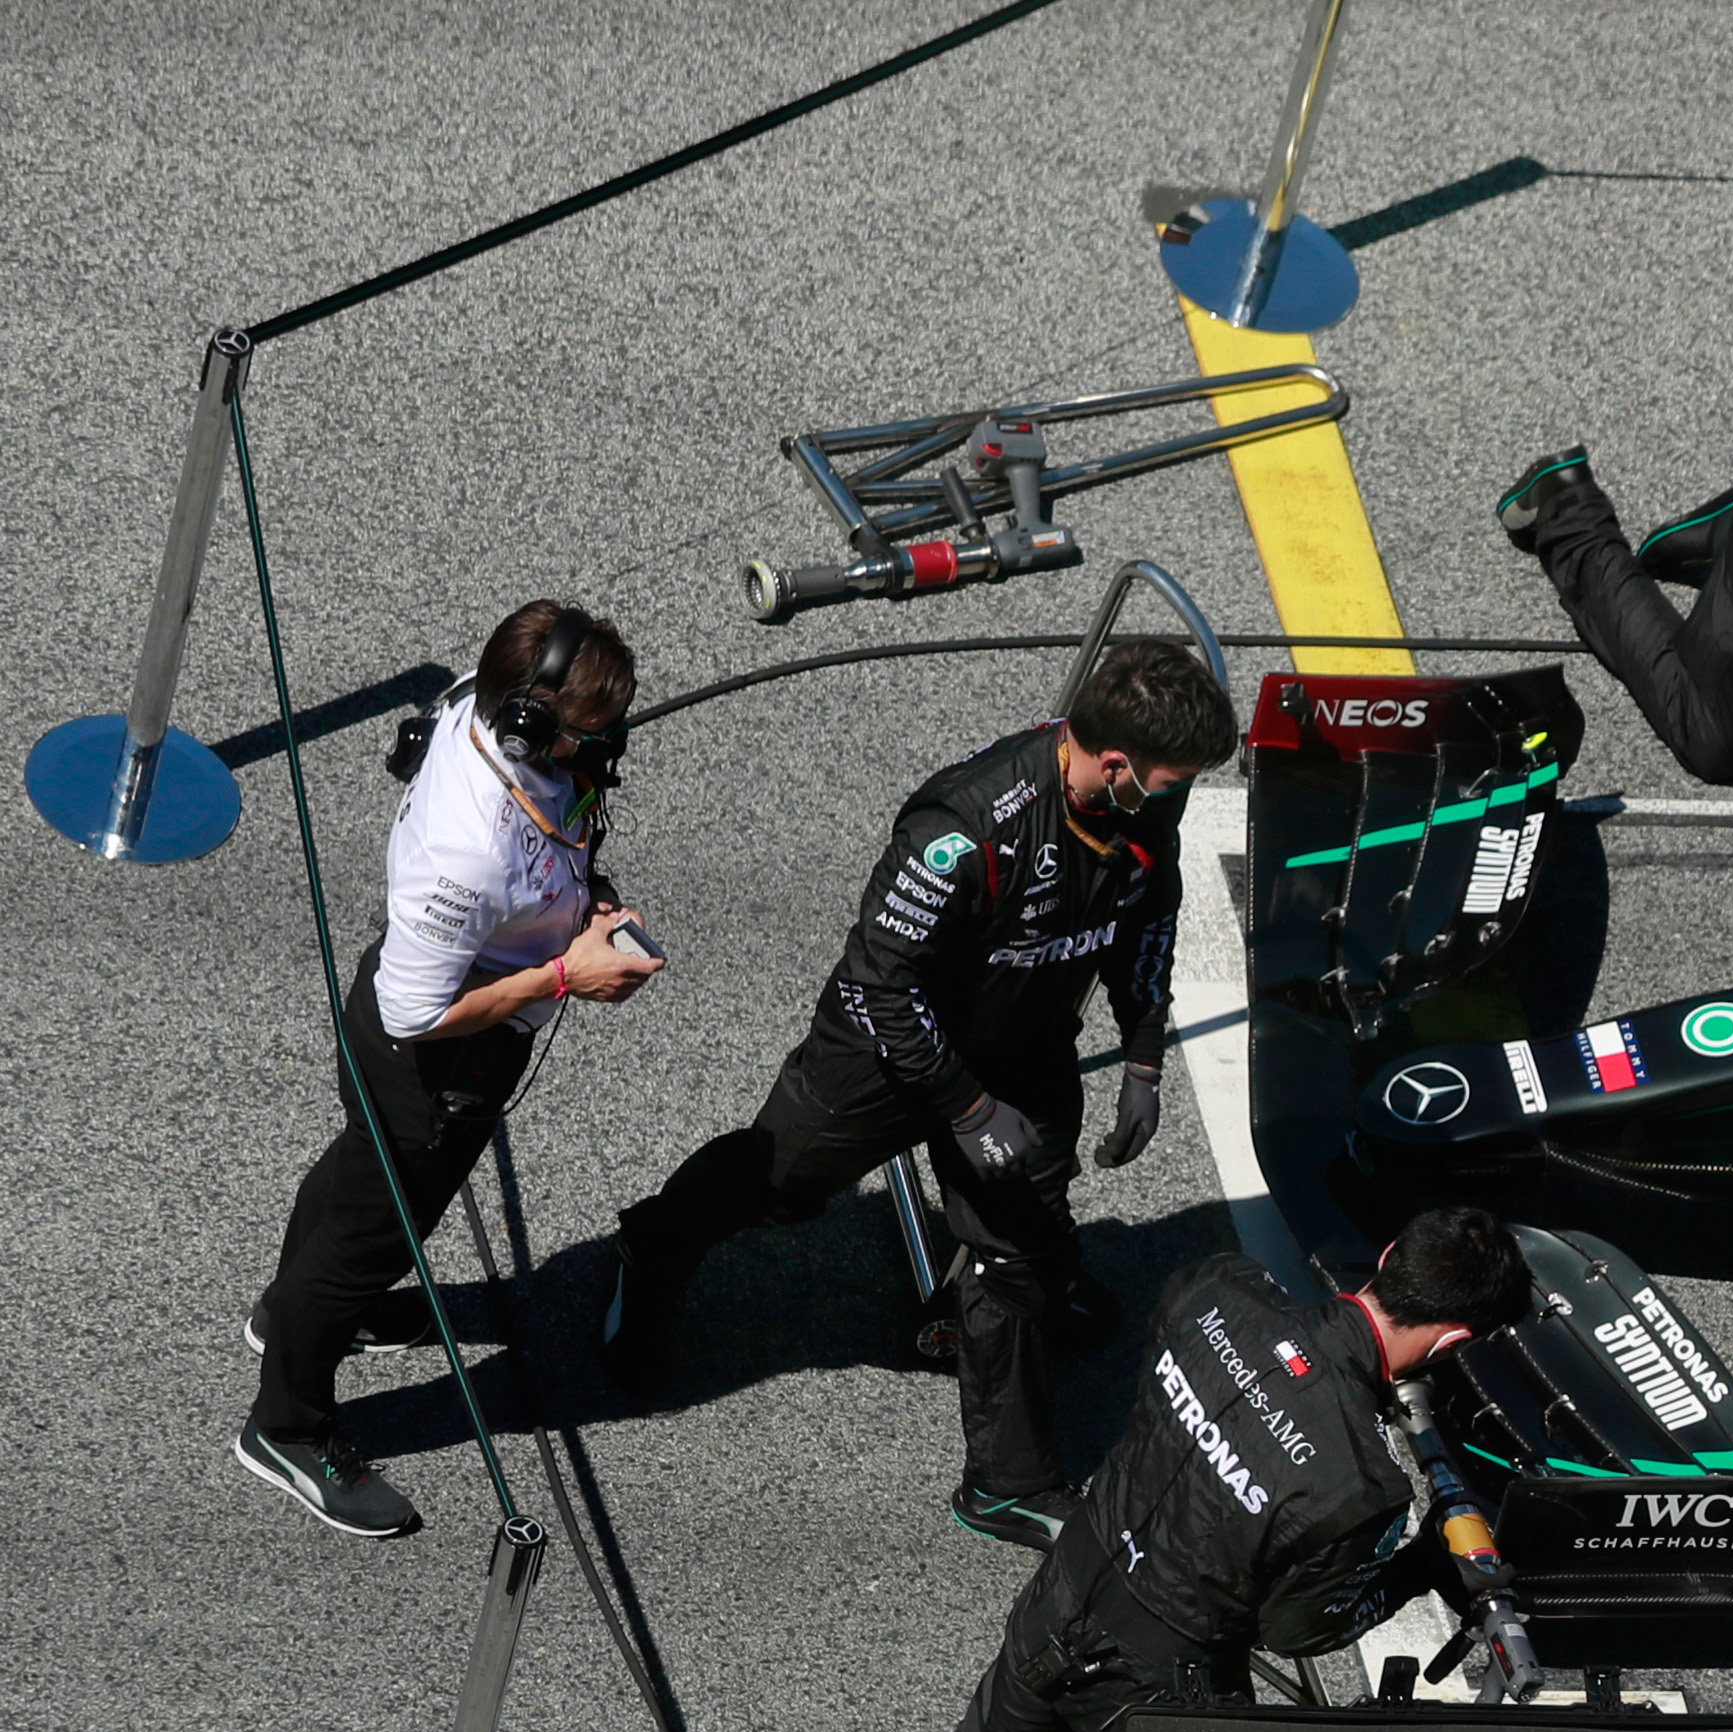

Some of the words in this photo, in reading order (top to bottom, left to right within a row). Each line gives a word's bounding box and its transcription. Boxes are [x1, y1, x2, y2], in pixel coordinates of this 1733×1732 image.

[992, 782, 1039, 825] BONVOY
[906, 856, 957, 894] PETRONAS
[1461, 825, 1521, 914] SYNTIUM
[1505, 811, 1545, 901] PETRONAS
[437, 876, 482, 904] EPSON
[895, 871, 948, 909] EPSON
[988, 922, 1118, 969] PETRON
[1502, 1039, 1549, 1115] PIRELLI
[1576, 1031, 1602, 1090] HILFIGER
[1620, 1022, 1646, 1079] TOMMY
[1593, 1313, 1709, 1432] SYNTIUM
[1632, 1286, 1730, 1404] PETRONAS
[1196, 1305, 1318, 1466] Mercedes-AMG
[1154, 1348, 1270, 1516] PETRONAS
